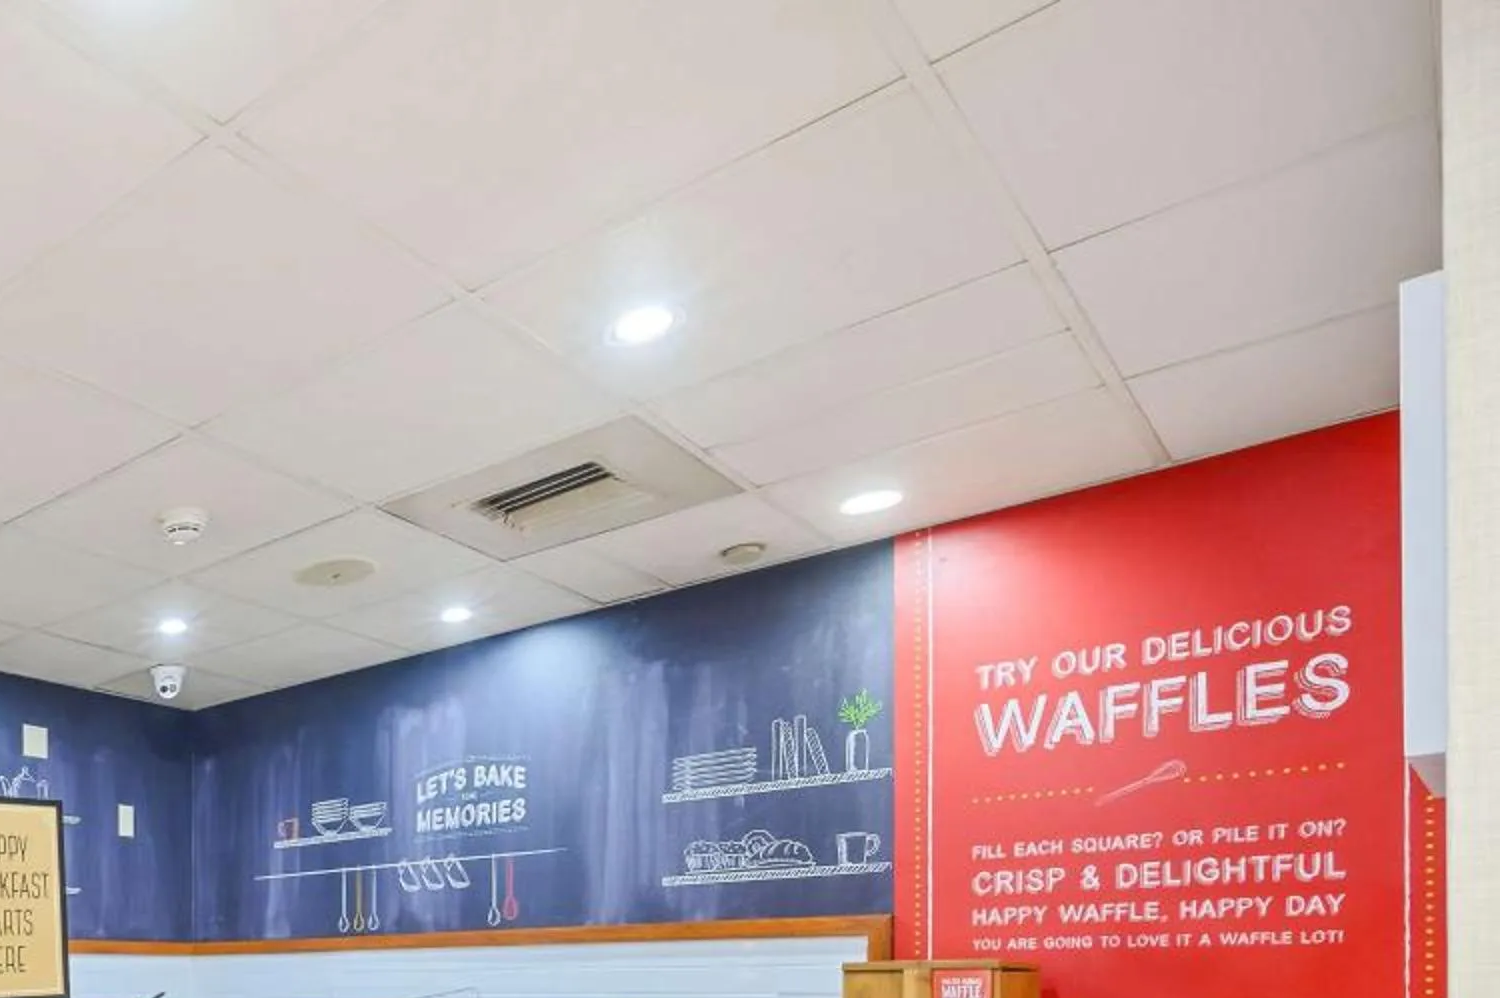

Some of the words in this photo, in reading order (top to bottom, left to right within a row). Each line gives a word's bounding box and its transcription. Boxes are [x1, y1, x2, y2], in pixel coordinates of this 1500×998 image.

[975, 656, 1038, 690] TRY
[1052, 643, 1127, 679] OUR
[1142, 605, 1351, 665] DELICIOUS
[974, 653, 1350, 757] WAFFLES
[417, 767, 467, 805] LET'S
[474, 764, 527, 789] BAKE
[417, 798, 526, 833] MEMORIES
[972, 844, 1007, 860] FILL
[1014, 839, 1064, 857] EACH
[1071, 832, 1163, 853] SQUARE?
[1172, 829, 1204, 846] OR
[1212, 825, 1260, 844] PILE
[1268, 823, 1289, 840] IT
[1299, 818, 1347, 838] ON?
[972, 867, 1066, 897] CRISP
[1081, 864, 1100, 890] &
[1116, 851, 1347, 889] DELIGHTFUL
[972, 905, 1048, 927] HAPPY
[1179, 896, 1273, 920] HAPPY
[1285, 893, 1346, 917] DAY
[972, 938, 1001, 951] YOU
[1007, 937, 1038, 950] ARE
[1043, 935, 1093, 949] GOING
[1101, 935, 1121, 948] TO
[1127, 933, 1169, 948] LOVE
[1176, 933, 1192, 947] IT
[1198, 933, 1212, 946] A
[1219, 931, 1293, 946] WAFFLE
[1300, 930, 1345, 945] LOT!
